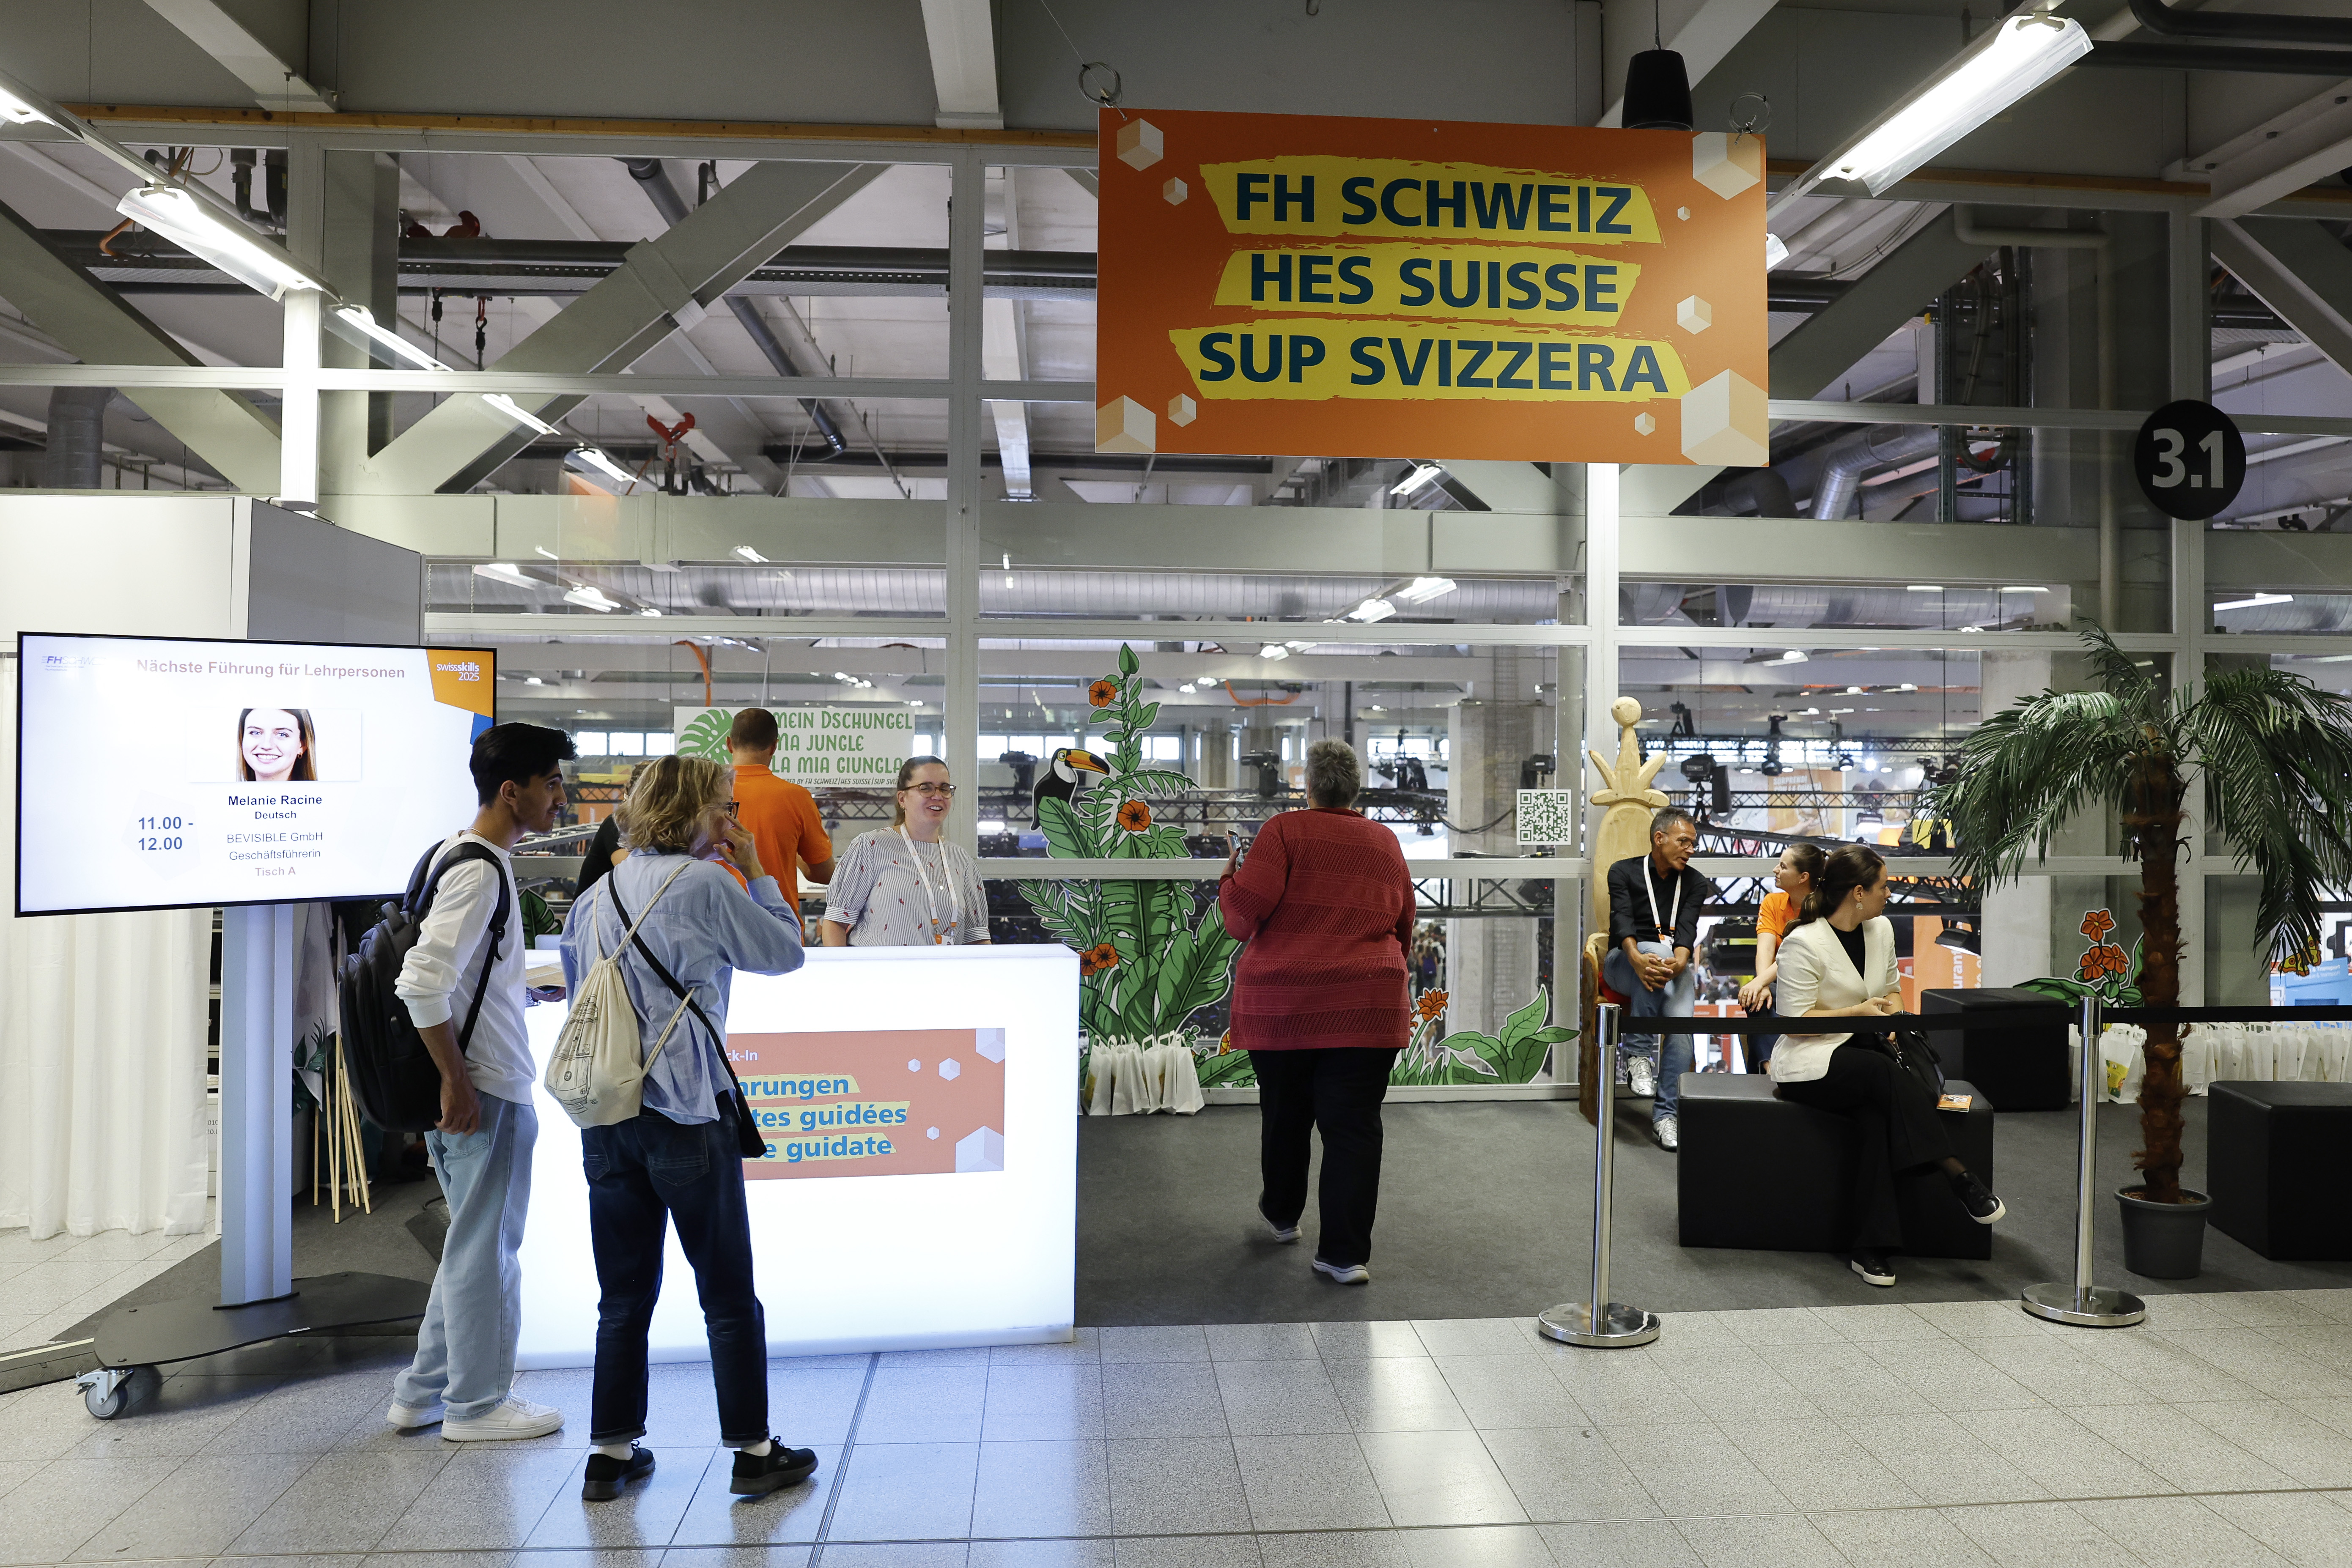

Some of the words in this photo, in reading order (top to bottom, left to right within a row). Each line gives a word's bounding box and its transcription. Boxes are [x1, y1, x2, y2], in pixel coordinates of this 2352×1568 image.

[1237, 173, 1315, 222] FH
[1342, 176, 1632, 234] SCHWEIZ
[1250, 253, 1373, 304] HES
[1400, 258, 1619, 312] SUISSE
[1199, 332, 1326, 384] SUP
[1350, 337, 1669, 393] SVIZZERA
[2152, 428, 2223, 488] 3.1
[137, 659, 203, 673] Nächste
[209, 661, 273, 678] Führung
[279, 663, 300, 675] für
[305, 664, 404, 679] Lehrpersonen
[436, 662, 480, 672] swissskills
[458, 672, 479, 681] 2025
[774, 712, 814, 728] MEIN
[822, 711, 912, 729] DSCHUNGEL
[777, 733, 799, 751] MA
[807, 735, 864, 751] JUNGLE
[772, 755, 790, 773] LA
[798, 757, 829, 773] MIA
[837, 757, 903, 773] GIUNGLA
[229, 795, 276, 805] Melanie
[281, 795, 322, 804] Racine
[139, 817, 181, 830] 11.00
[255, 811, 296, 819] Deutsch
[139, 837, 182, 850] 12.00
[227, 833, 286, 843] BEVISIBLE
[291, 832, 323, 841] GmbH
[229, 849, 321, 860] Geschäftsführerin
[255, 867, 285, 876] Tisch
[288, 866, 296, 875] A
[800, 1104, 907, 1131] guidées
[786, 1135, 892, 1163] guidate
